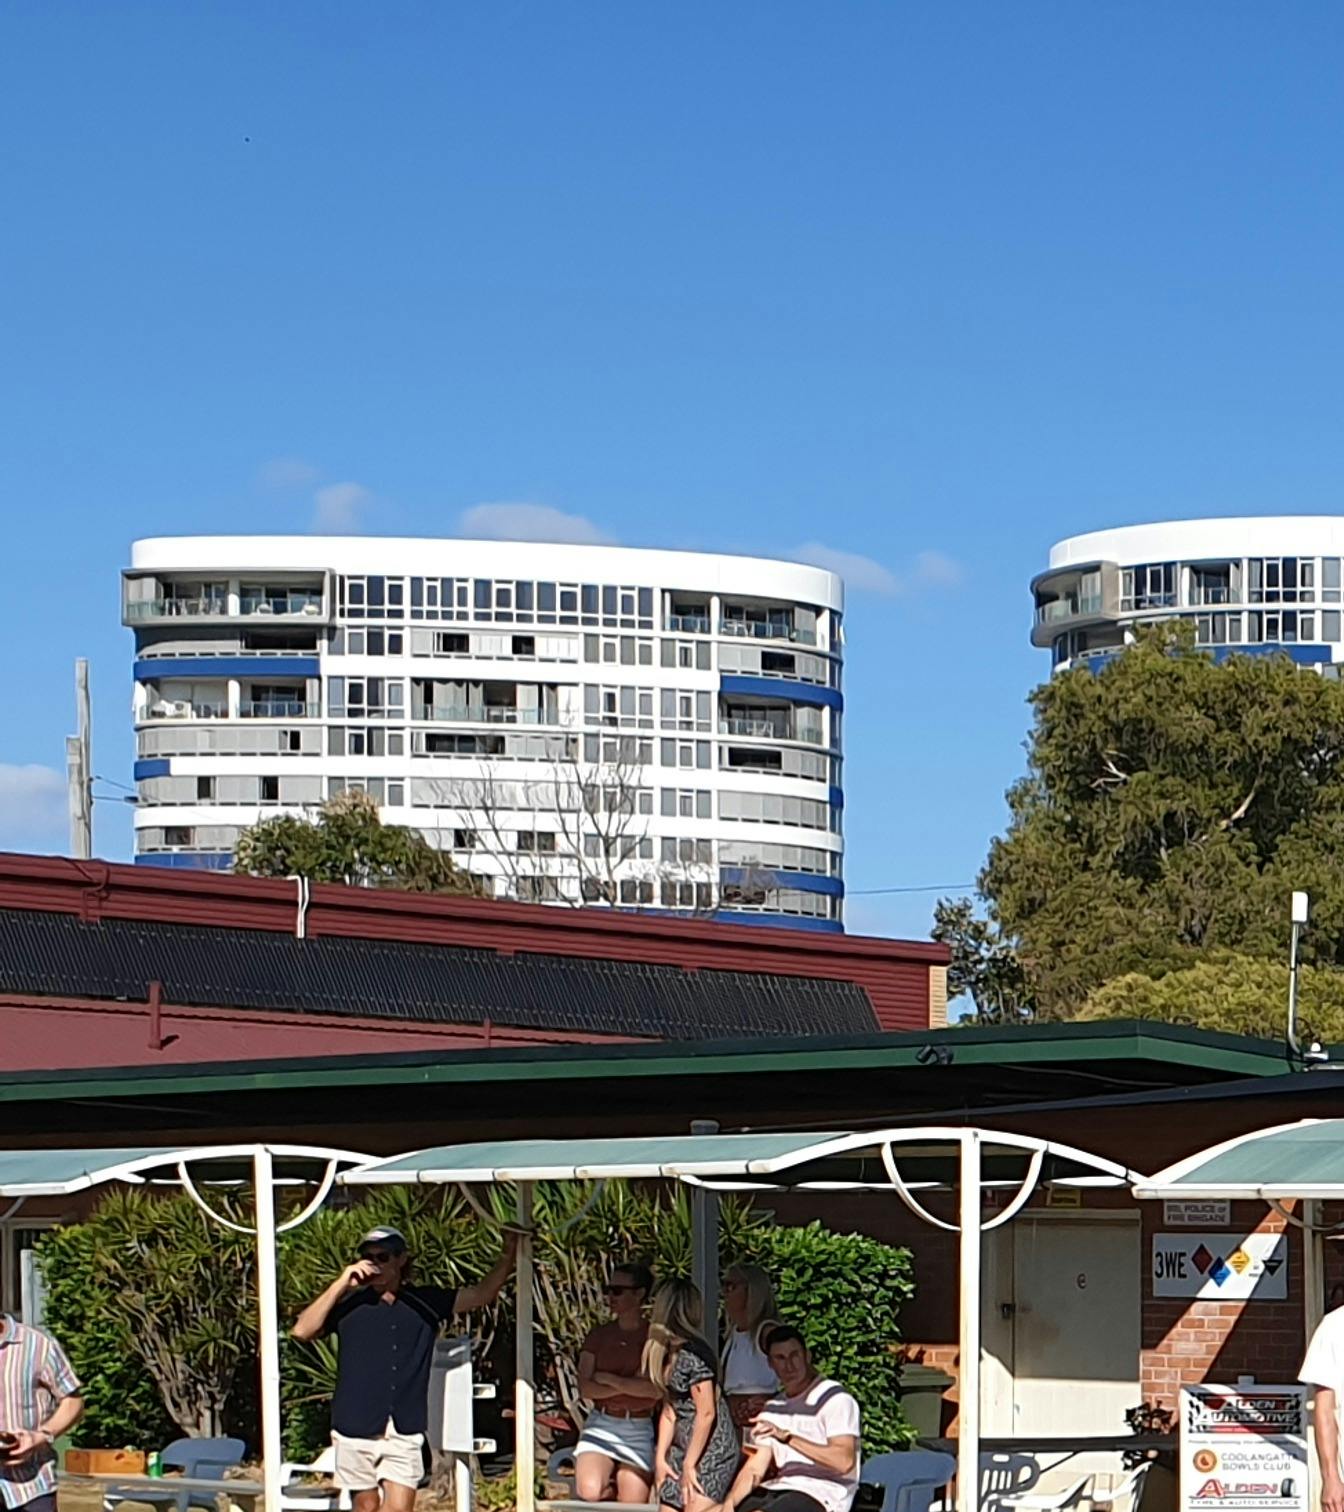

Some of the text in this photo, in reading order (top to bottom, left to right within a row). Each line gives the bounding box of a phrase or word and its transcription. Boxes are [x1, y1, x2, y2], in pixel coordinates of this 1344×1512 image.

[1154, 1251, 1188, 1279] 3WE
[1200, 1410, 1298, 1423] AUTOMOTIVE
[1222, 1462, 1291, 1471] BOWLS CLUB
